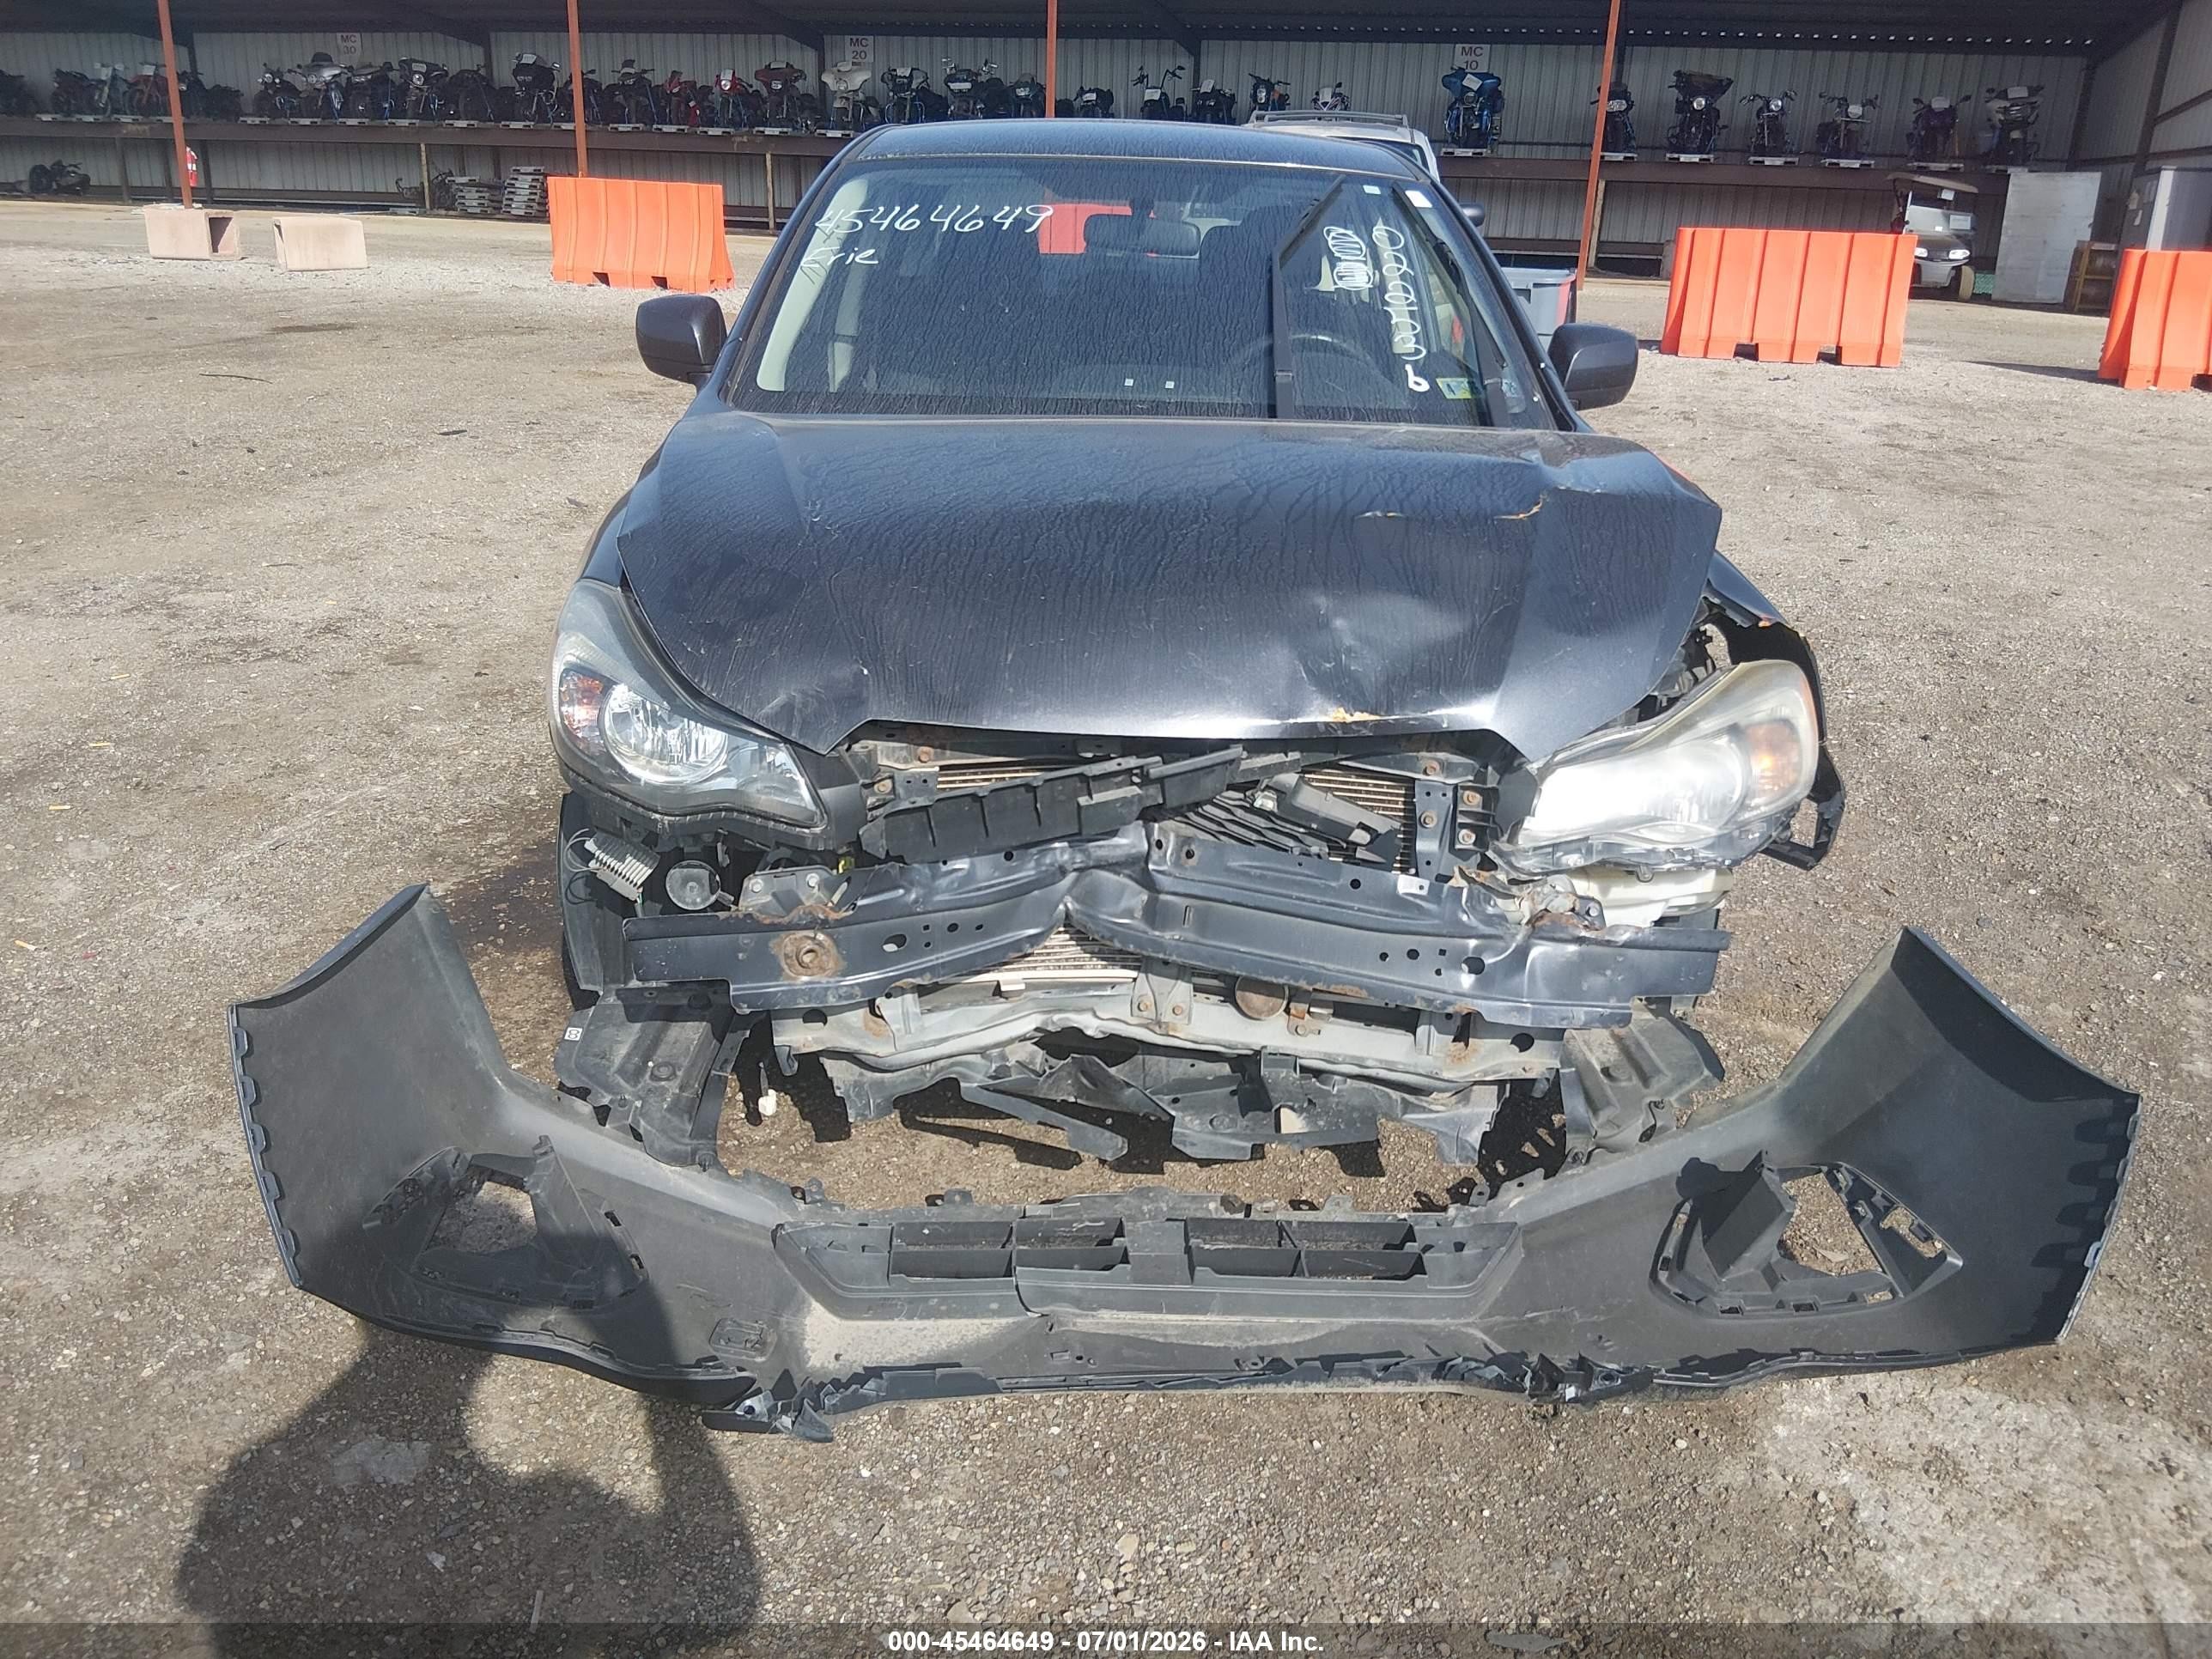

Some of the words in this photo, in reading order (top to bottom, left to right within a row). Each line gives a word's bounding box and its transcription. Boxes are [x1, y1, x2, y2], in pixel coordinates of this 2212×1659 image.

[340, 34, 357, 44] MC
[849, 38, 869, 48] MC
[852, 50, 867, 60] 20
[1461, 46, 1484, 58] MC
[1463, 60, 1479, 70] 10
